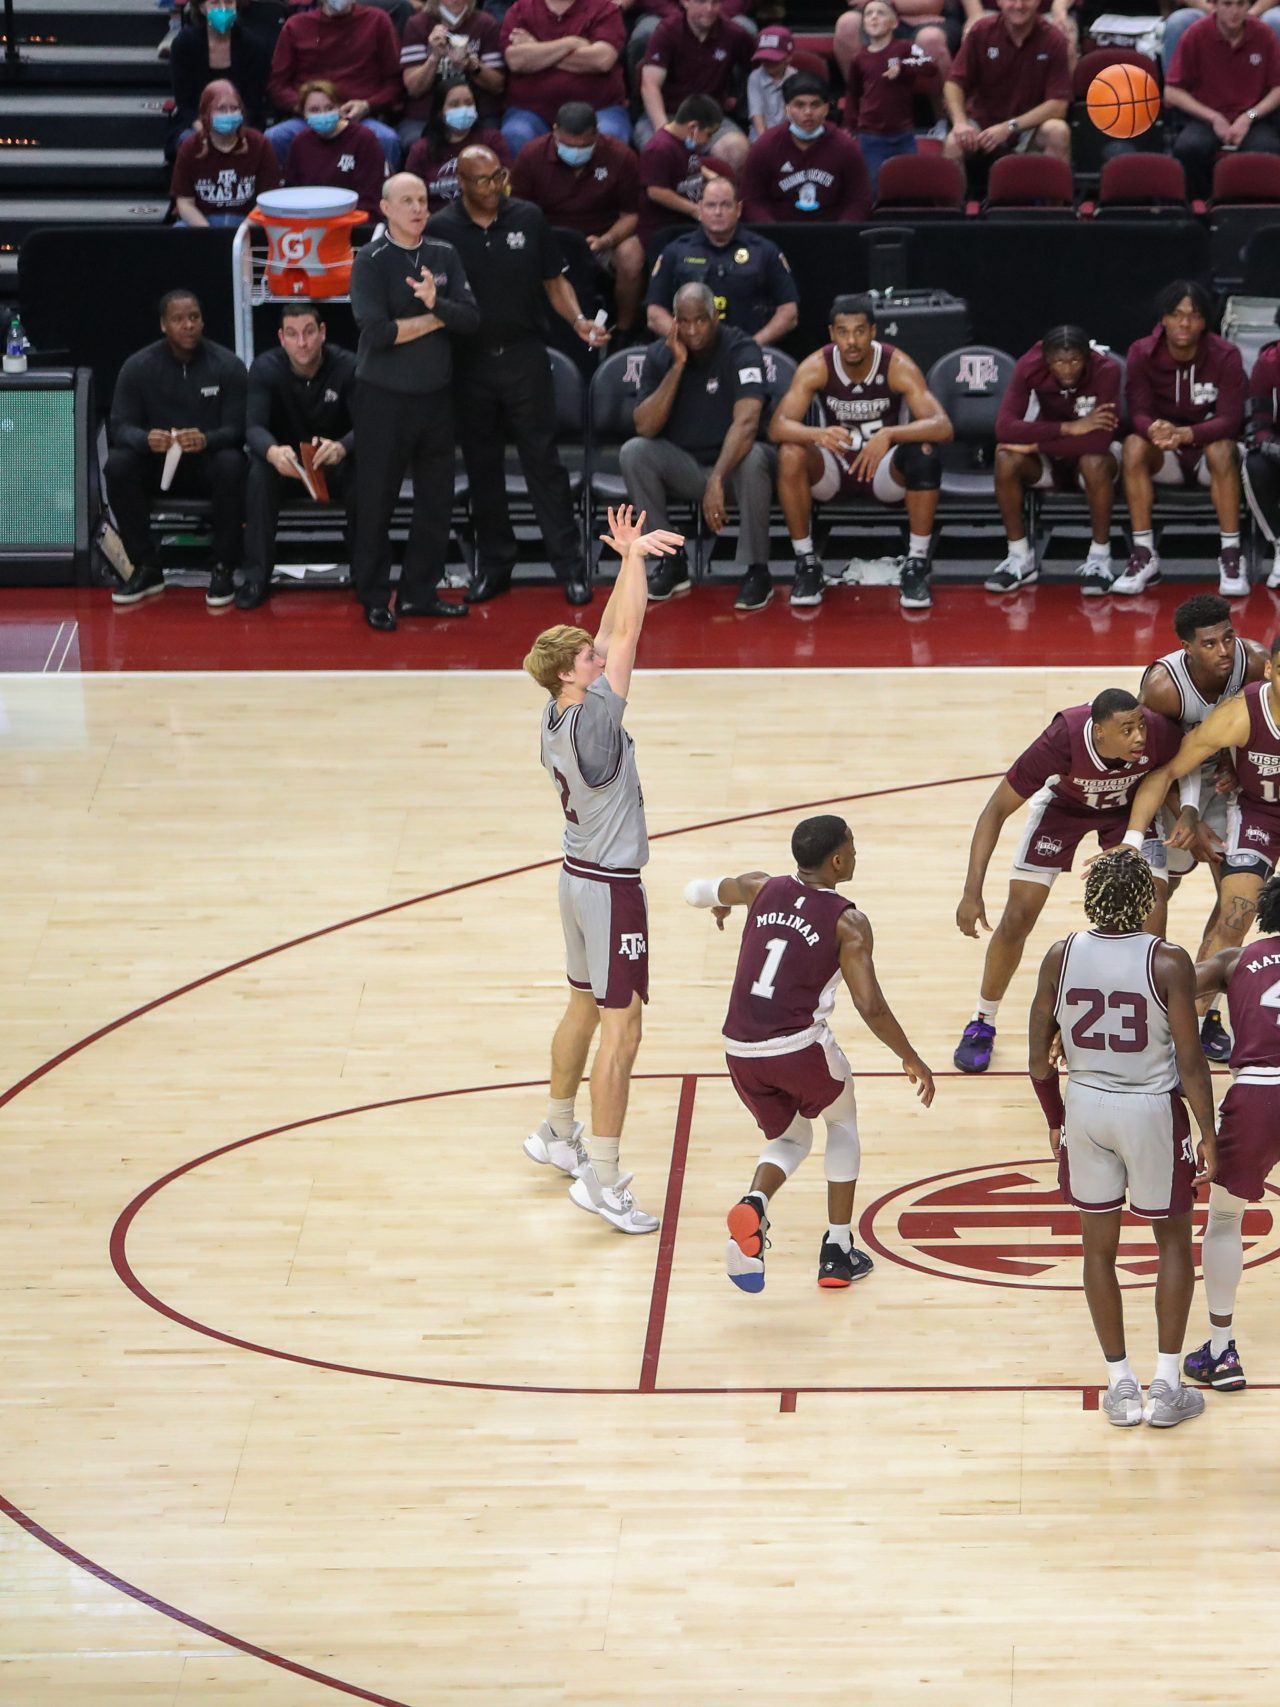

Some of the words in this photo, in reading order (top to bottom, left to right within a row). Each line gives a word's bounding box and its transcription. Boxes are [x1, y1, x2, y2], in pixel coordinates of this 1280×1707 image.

[553, 766, 580, 825] 2
[1074, 770, 1148, 787] MISSISSIP
[1084, 790, 1129, 810] 13
[756, 912, 820, 947] MOLINAR
[750, 938, 788, 999] 1
[1065, 987, 1148, 1053] 23
